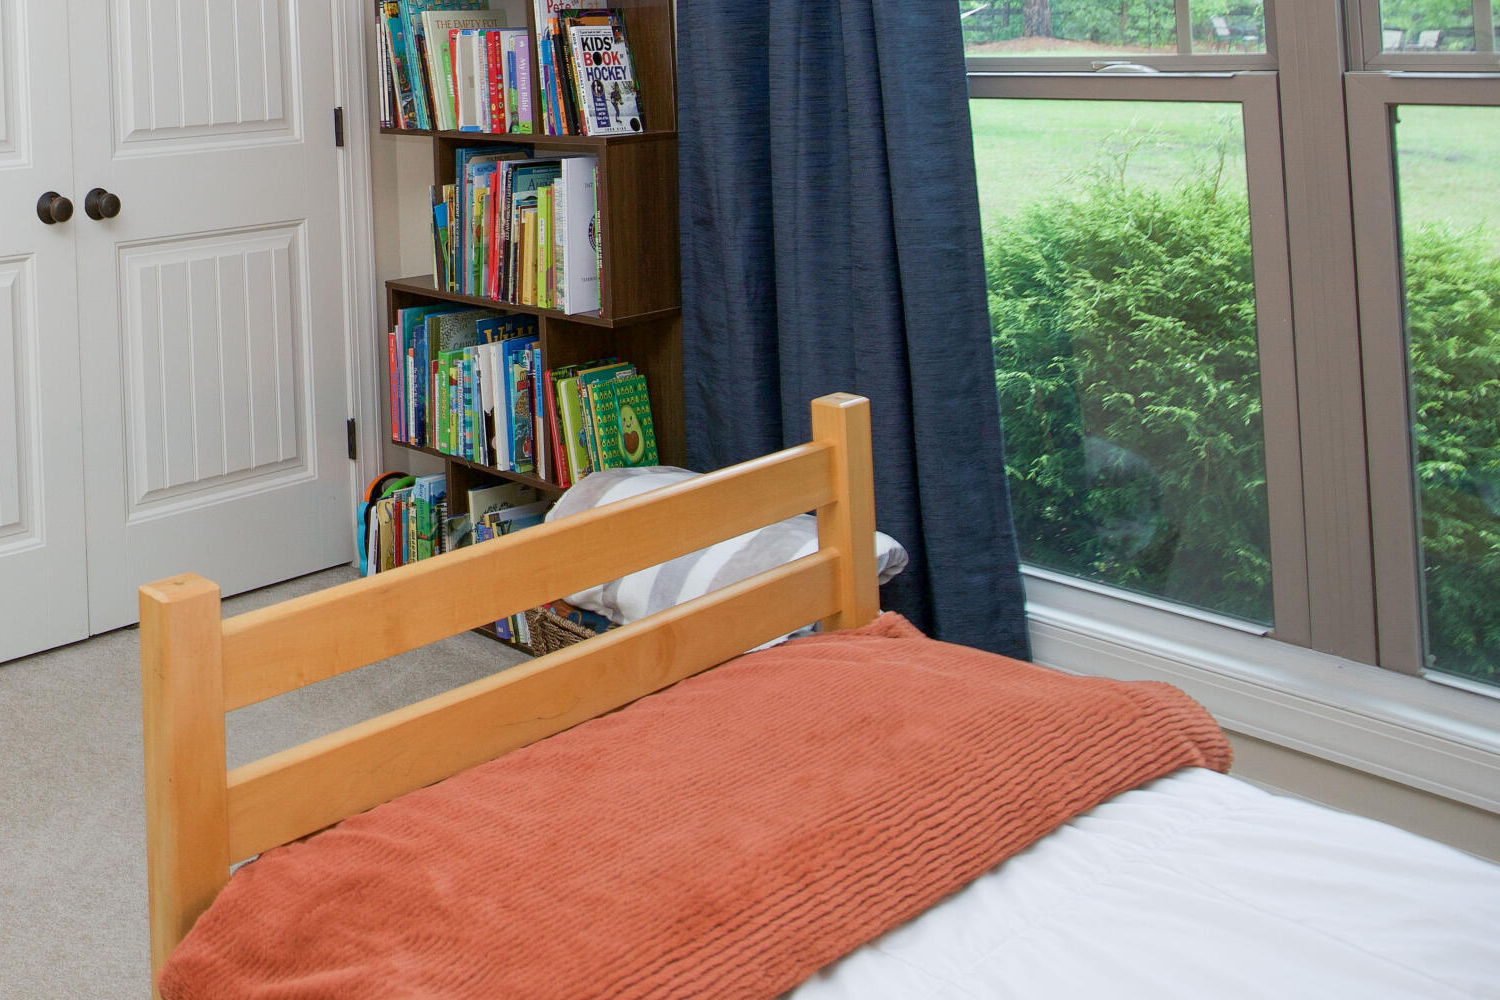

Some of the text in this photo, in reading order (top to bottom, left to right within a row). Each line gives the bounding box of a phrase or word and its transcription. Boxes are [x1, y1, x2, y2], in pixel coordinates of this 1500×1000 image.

[436, 20, 452, 29] THE
[454, 19, 480, 28] EMPTY
[581, 36, 613, 51] KIDS'
[520, 72, 528, 90] First
[586, 66, 627, 81] HOCKEY
[521, 92, 529, 112] Bible
